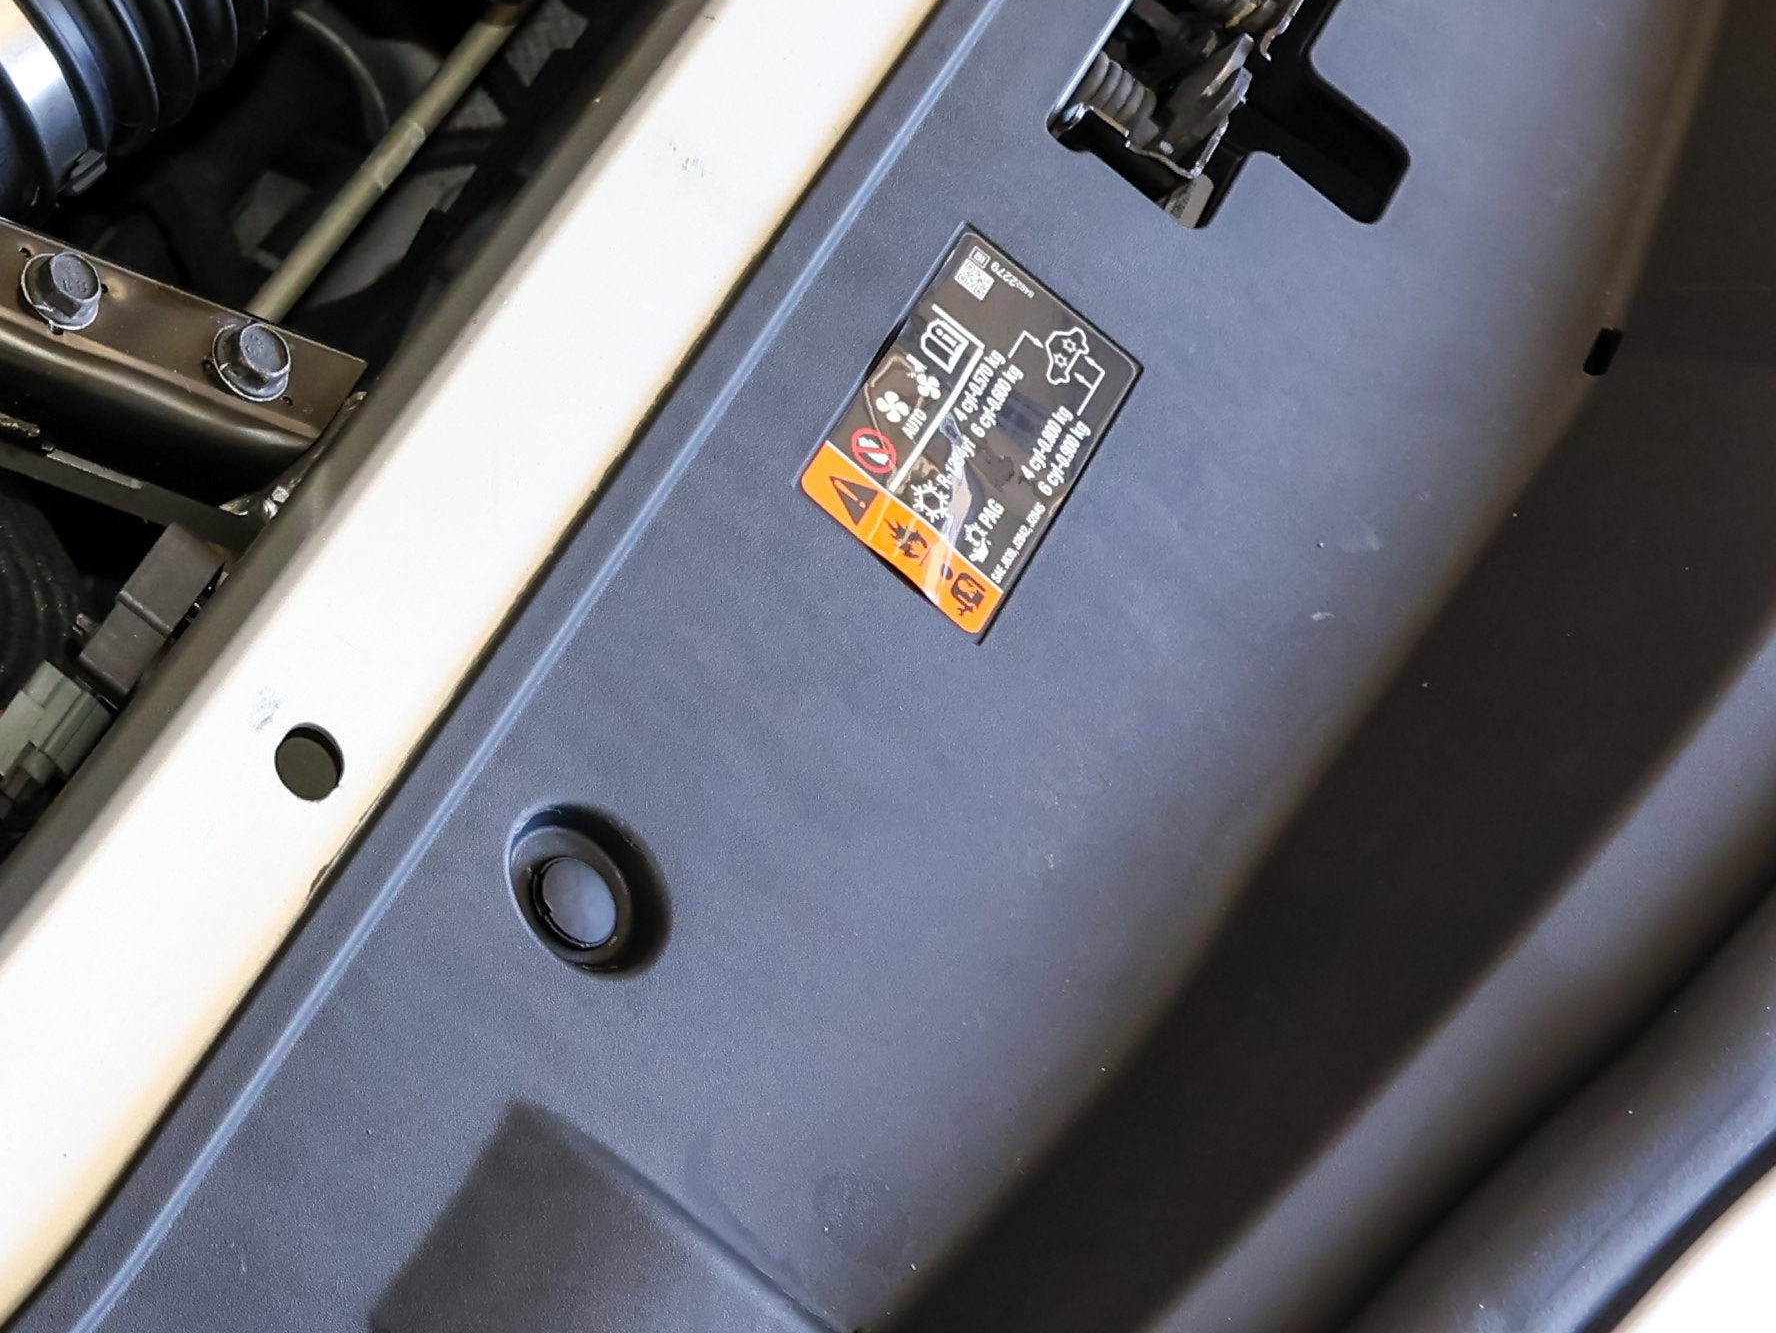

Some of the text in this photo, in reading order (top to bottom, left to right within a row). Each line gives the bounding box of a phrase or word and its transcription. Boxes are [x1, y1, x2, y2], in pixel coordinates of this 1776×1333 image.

[954, 349, 1006, 422] 4 cyl-0.570 kg
[970, 423, 986, 438] 6
[1002, 364, 1024, 384] kg
[902, 408, 927, 440] AUTO
[1020, 464, 1036, 480] 4
[1052, 405, 1074, 426] kg
[1038, 481, 1053, 497] 6
[1070, 420, 1092, 440] kg
[978, 498, 1005, 530] PAG
[991, 564, 1007, 584] SAE
